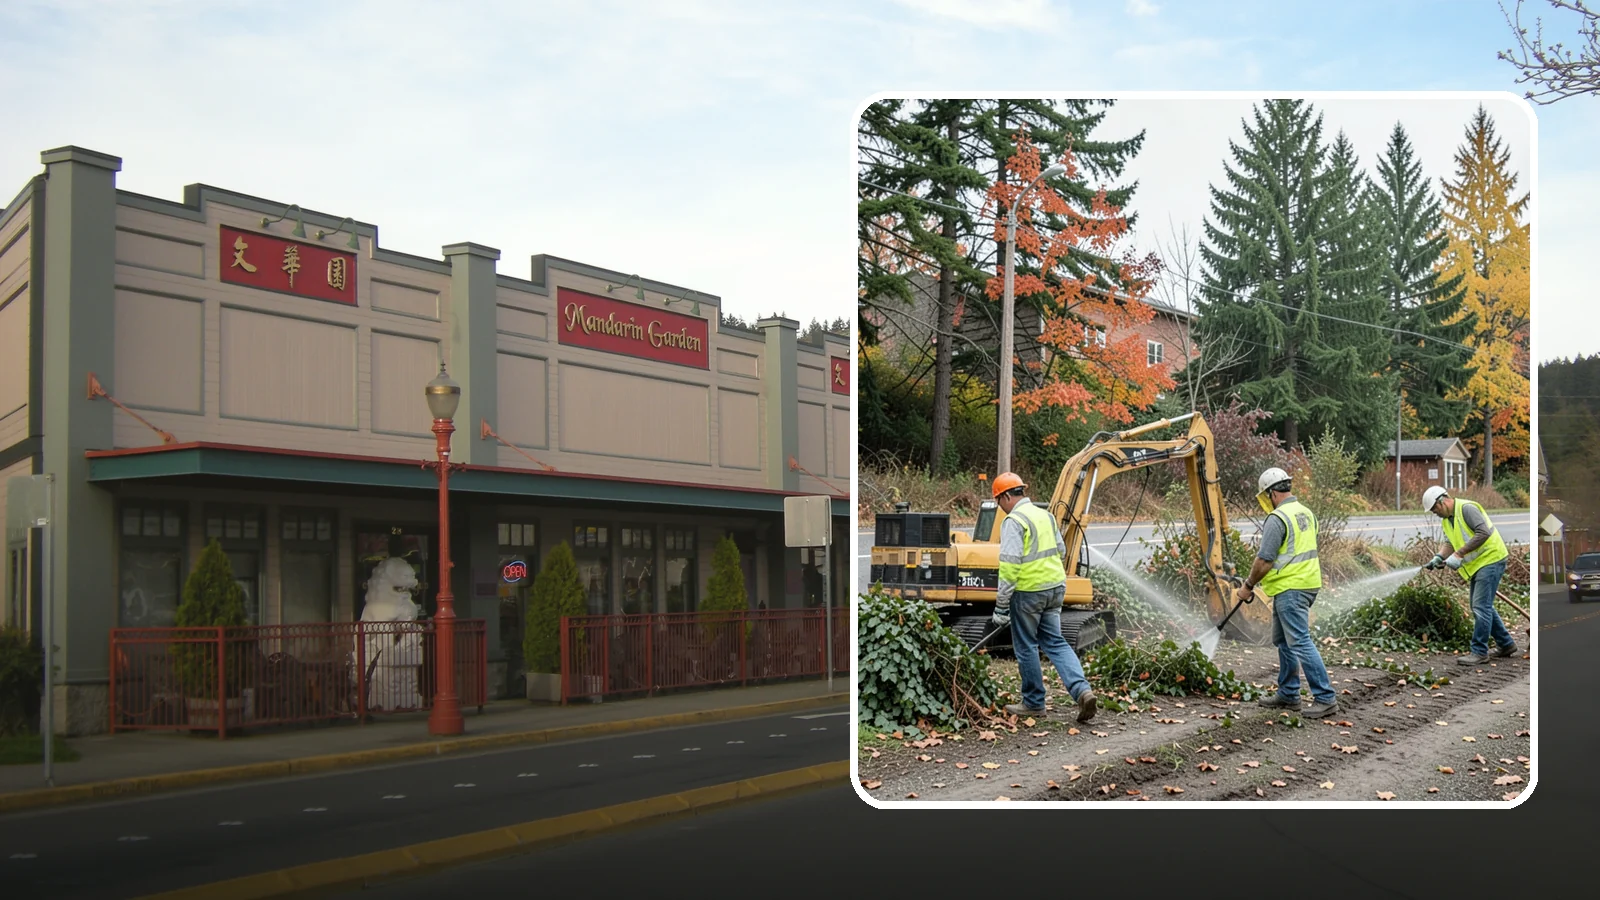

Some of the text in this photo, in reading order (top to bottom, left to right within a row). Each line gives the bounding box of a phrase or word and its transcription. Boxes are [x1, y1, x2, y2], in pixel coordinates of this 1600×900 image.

[230, 235, 346, 291] 文華園
[564, 302, 701, 352] Mandarin Garden
[503, 565, 527, 578] OPEN
